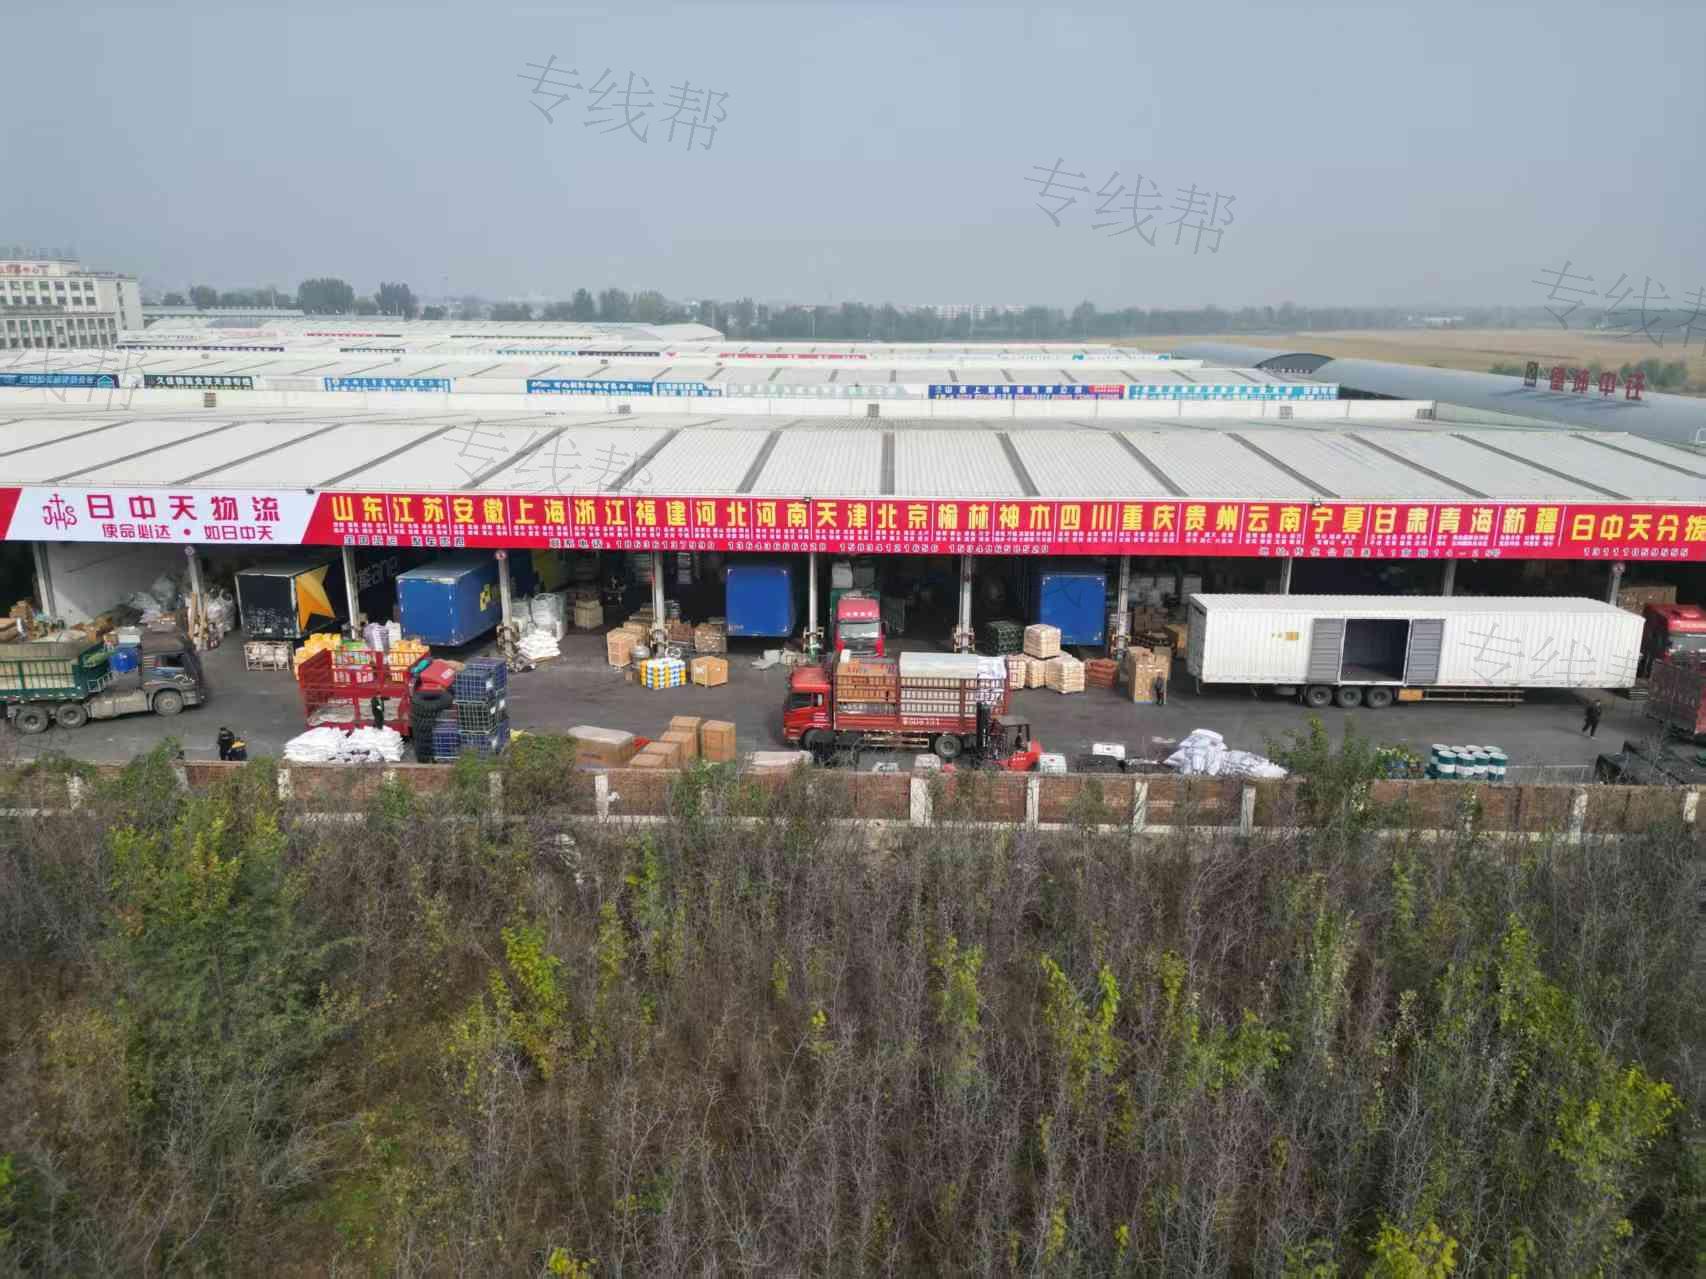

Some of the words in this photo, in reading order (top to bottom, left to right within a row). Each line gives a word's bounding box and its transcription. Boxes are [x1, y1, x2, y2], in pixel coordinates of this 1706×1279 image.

[87, 494, 280, 522] 日中天物流
